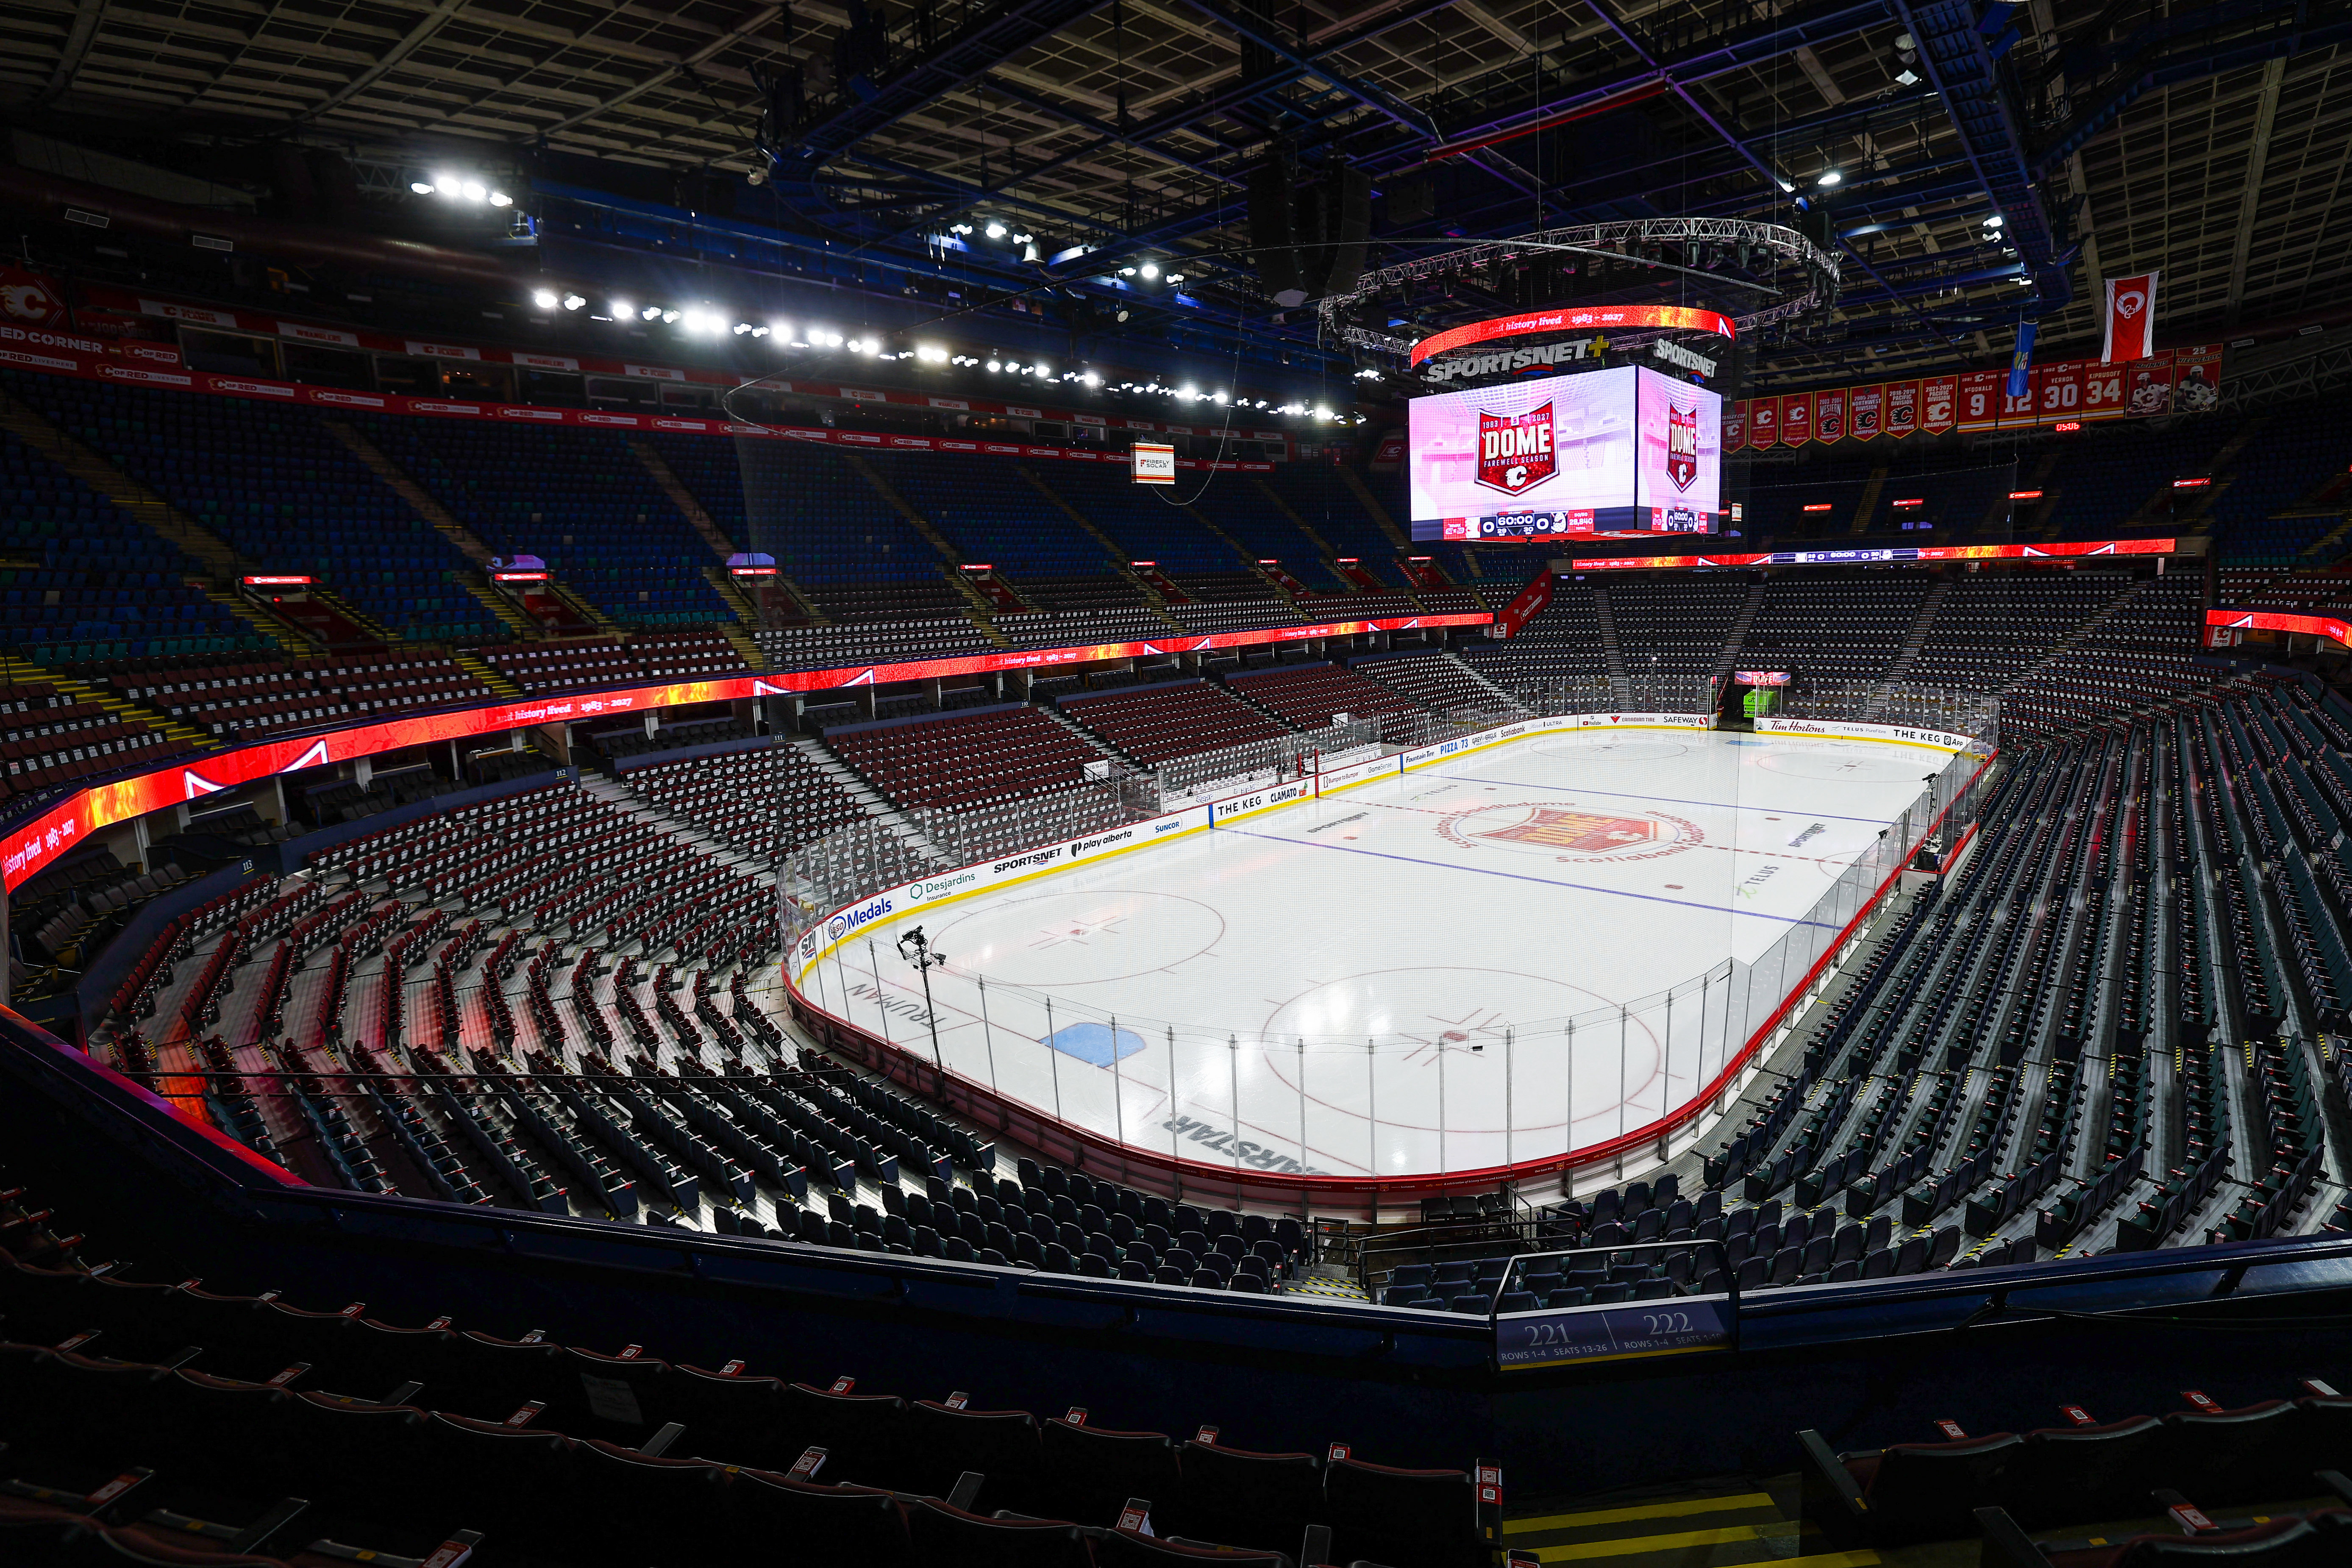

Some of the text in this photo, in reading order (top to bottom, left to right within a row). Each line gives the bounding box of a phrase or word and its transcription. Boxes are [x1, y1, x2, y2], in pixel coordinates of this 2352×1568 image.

[1506, 320, 1537, 331] history
[1539, 316, 1562, 325] lived
[1571, 314, 1593, 324] 1983
[1602, 313, 1624, 321] 2027
[296, 329, 342, 342] WRANGLERS
[28, 332, 103, 353] CORNER
[10, 353, 32, 362] RED
[156, 352, 176, 360] RED
[2177, 353, 2222, 362] NIEUWENDYK
[2192, 347, 2207, 355] 25
[1656, 338, 1717, 378] SPORTSNET
[128, 371, 148, 379] RED
[2051, 375, 2074, 384] VERNON
[2089, 370, 2121, 379] KIPRUSOFF
[1889, 388, 1916, 396] 2018-2019
[1925, 384, 1954, 392] 2021-2022
[2086, 378, 2121, 404] 34
[1852, 398, 1882, 406] NORTHWEST
[2004, 389, 2033, 413] 12
[2044, 383, 2078, 409] 30
[1820, 403, 1841, 418] WESTERN
[1970, 393, 1985, 416] 9
[1483, 413, 1549, 429] 1983 2027
[1484, 454, 1548, 467] FAREWELL SEASON
[1671, 453, 1684, 461] FAREWELL
[1498, 515, 1533, 525] 60:00
[1669, 515, 1674, 526] 0
[1675, 512, 1688, 521] 60:00
[1688, 517, 1693, 528] 0
[1483, 521, 1495, 533] 0
[1536, 518, 1549, 530] 0
[1046, 653, 1059, 661] 1983
[515, 708, 546, 719] history
[548, 703, 572, 715] lived
[581, 701, 602, 712] 1983
[611, 698, 632, 707] 2027
[1663, 716, 1698, 724] SAFEWAY
[1771, 720, 1825, 733] Tim Hortons
[1501, 725, 1525, 738] Scotiabank
[1893, 729, 1940, 742] THE KEG
[1441, 742, 1458, 754] PIZZA
[1461, 739, 1468, 748] 73
[1406, 750, 1435, 763] Fountain Tire
[556, 769, 566, 777] 112
[1368, 762, 1392, 773] GameSense
[1329, 775, 1342, 784] Bumper
[1346, 772, 1359, 781] Bumper
[1271, 787, 1297, 803] CLAMATO
[1425, 784, 1458, 795] TELUS
[1218, 796, 1262, 815] THE KEG
[1307, 812, 1370, 833] SPORTSNET
[25, 836, 42, 861] lived
[46, 827, 60, 850] 1983
[62, 819, 74, 836] 2027
[1083, 831, 1132, 851] play alberta
[1788, 823, 1827, 848] SPORTSNET
[994, 848, 1062, 873] SPORTSNET
[1556, 845, 1690, 863] Scotiabank
[243, 860, 253, 871] 113
[1744, 865, 1779, 884] TELUS
[926, 873, 975, 893] Desjardins
[927, 891, 951, 901] Insurance
[847, 898, 892, 930] Medals
[801, 930, 816, 956] SN
[845, 984, 947, 1029] TRUMAN
[1643, 1312, 1693, 1334] 222
[1524, 1323, 1572, 1346] 221
[1624, 1340, 1652, 1349] ROWS
[1676, 1336, 1701, 1344] SEATS
[1501, 1351, 1529, 1360] ROWS
[1554, 1347, 1580, 1355] SEATS
[1582, 1344, 1607, 1352] 13-26
